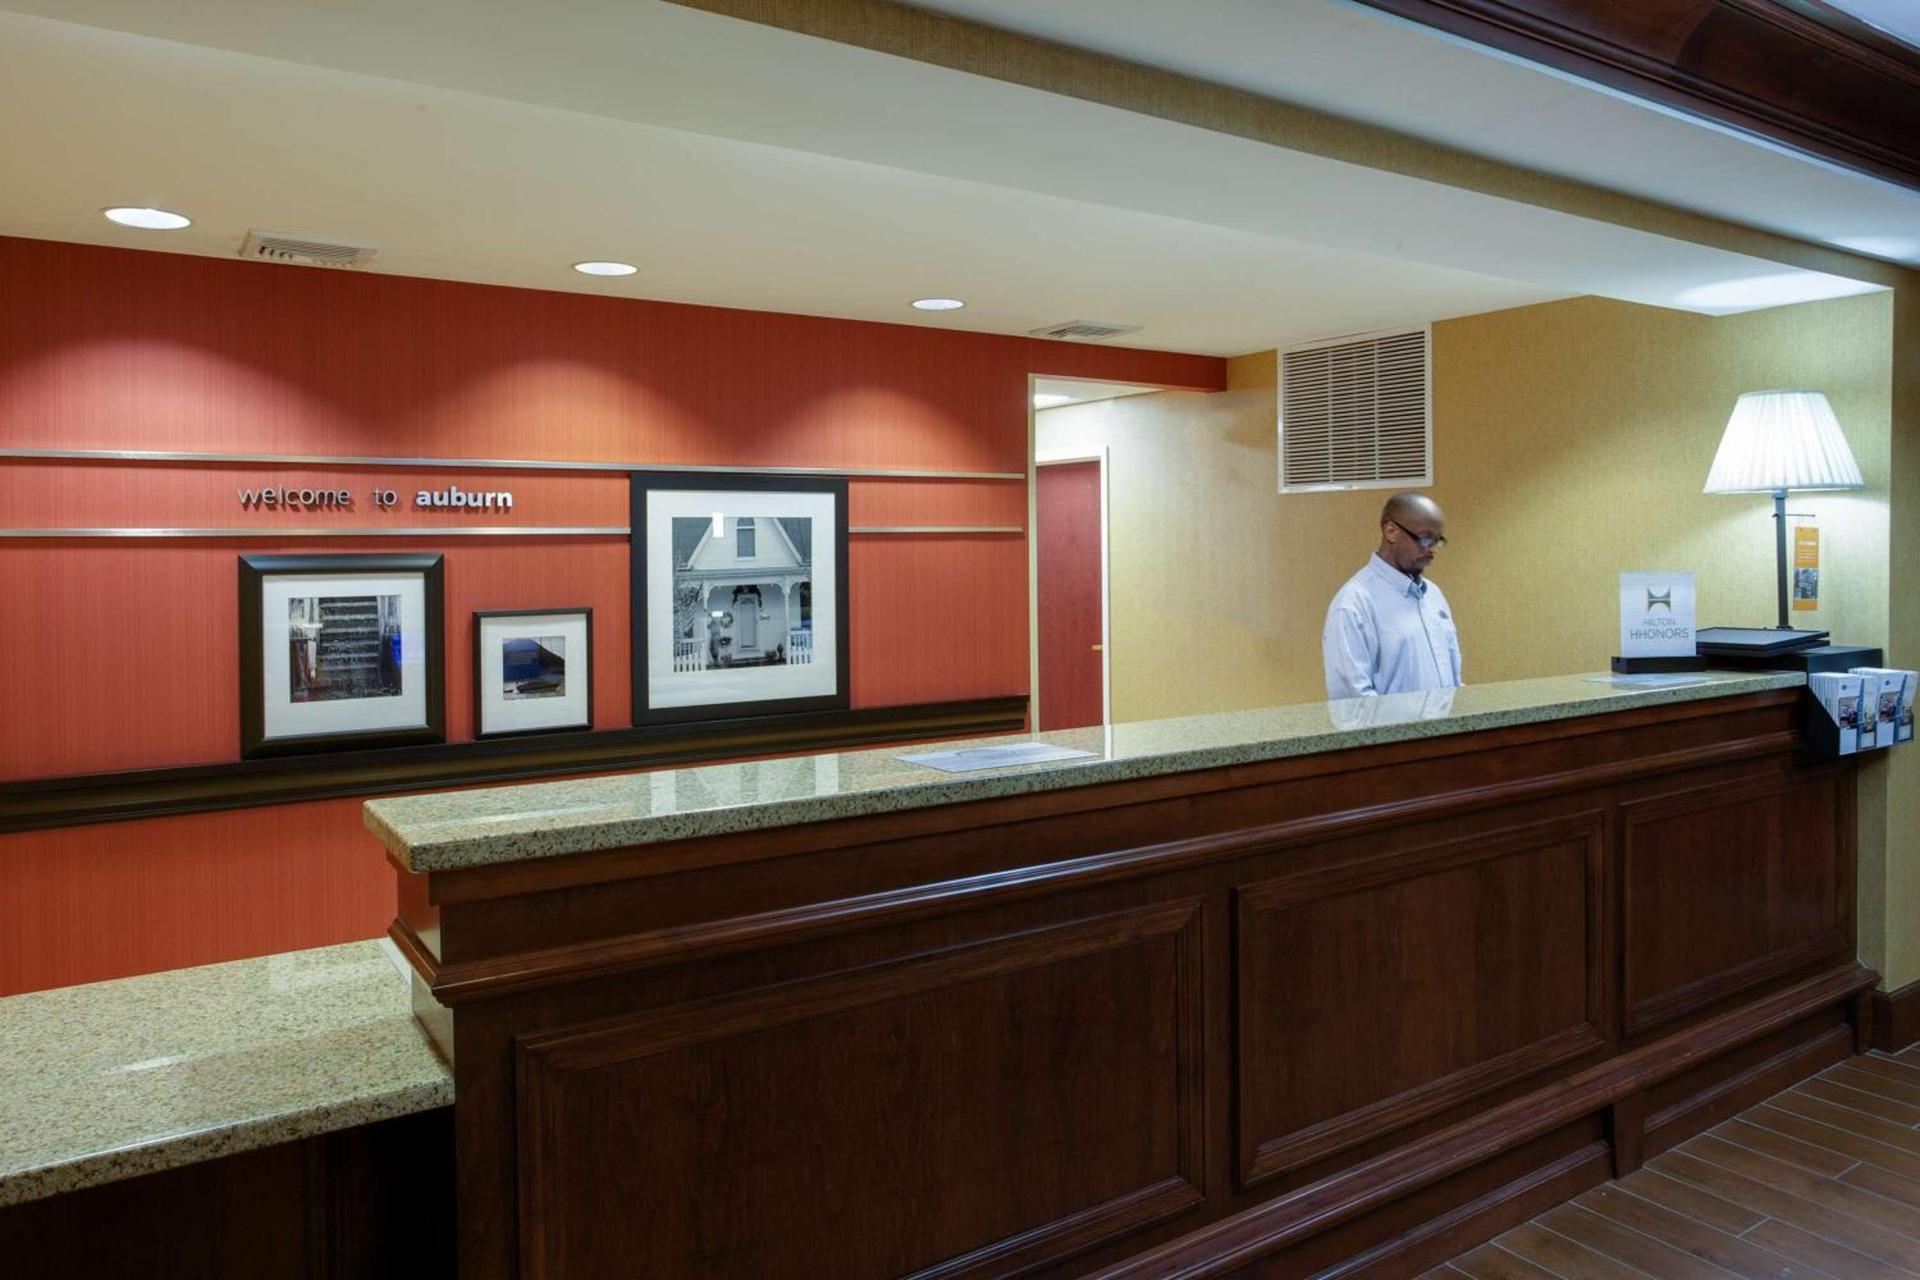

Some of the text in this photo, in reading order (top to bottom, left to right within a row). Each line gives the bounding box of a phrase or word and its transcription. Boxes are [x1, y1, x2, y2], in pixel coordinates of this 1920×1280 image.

[237, 484, 513, 508] welcome to auburn
[1630, 627, 1690, 641] HHONORS
